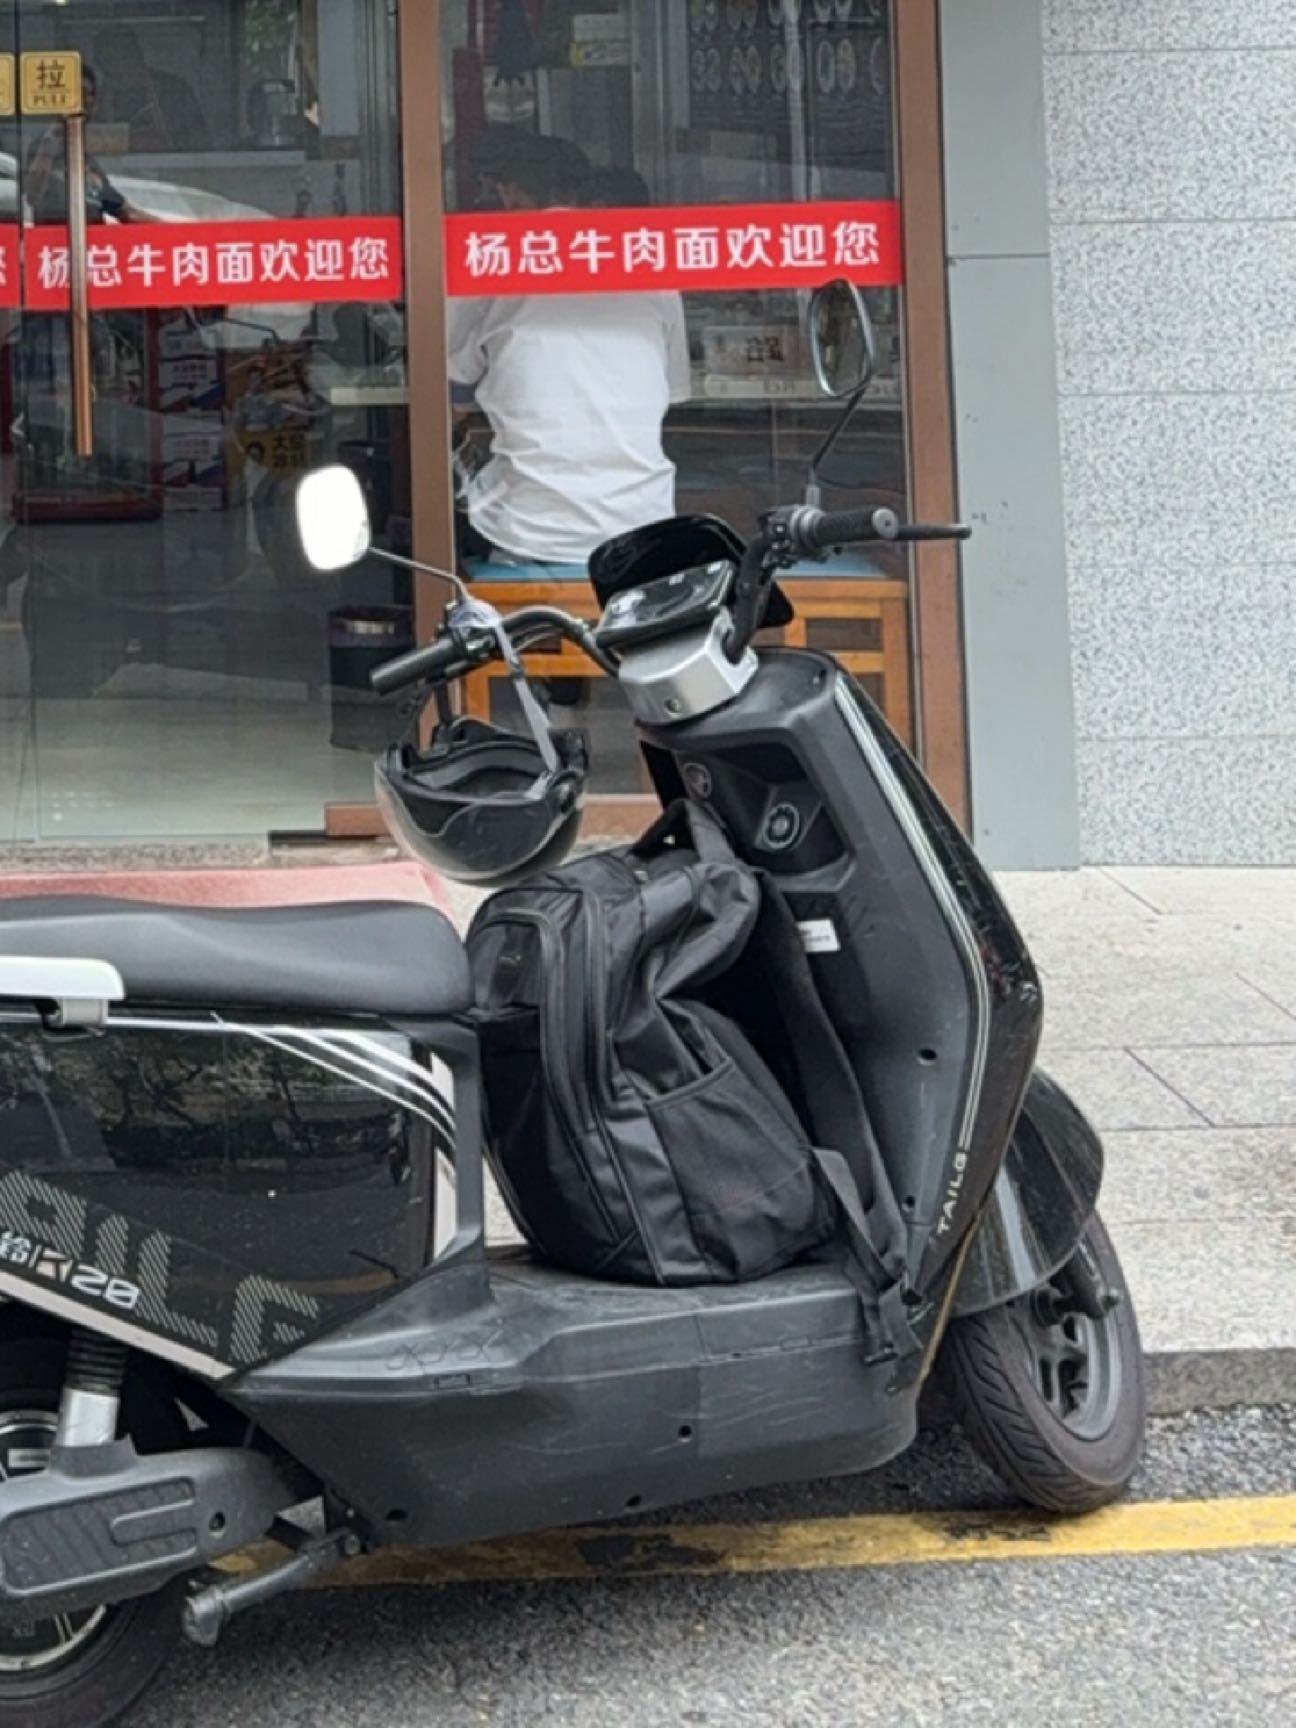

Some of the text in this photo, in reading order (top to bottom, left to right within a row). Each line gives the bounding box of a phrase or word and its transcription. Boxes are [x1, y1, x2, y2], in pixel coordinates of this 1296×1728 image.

[35, 58, 67, 90] 拉
[37, 235, 391, 290] 杨总牛肉面欢迎您
[464, 221, 881, 278] 杨总牛肉面欢迎您
